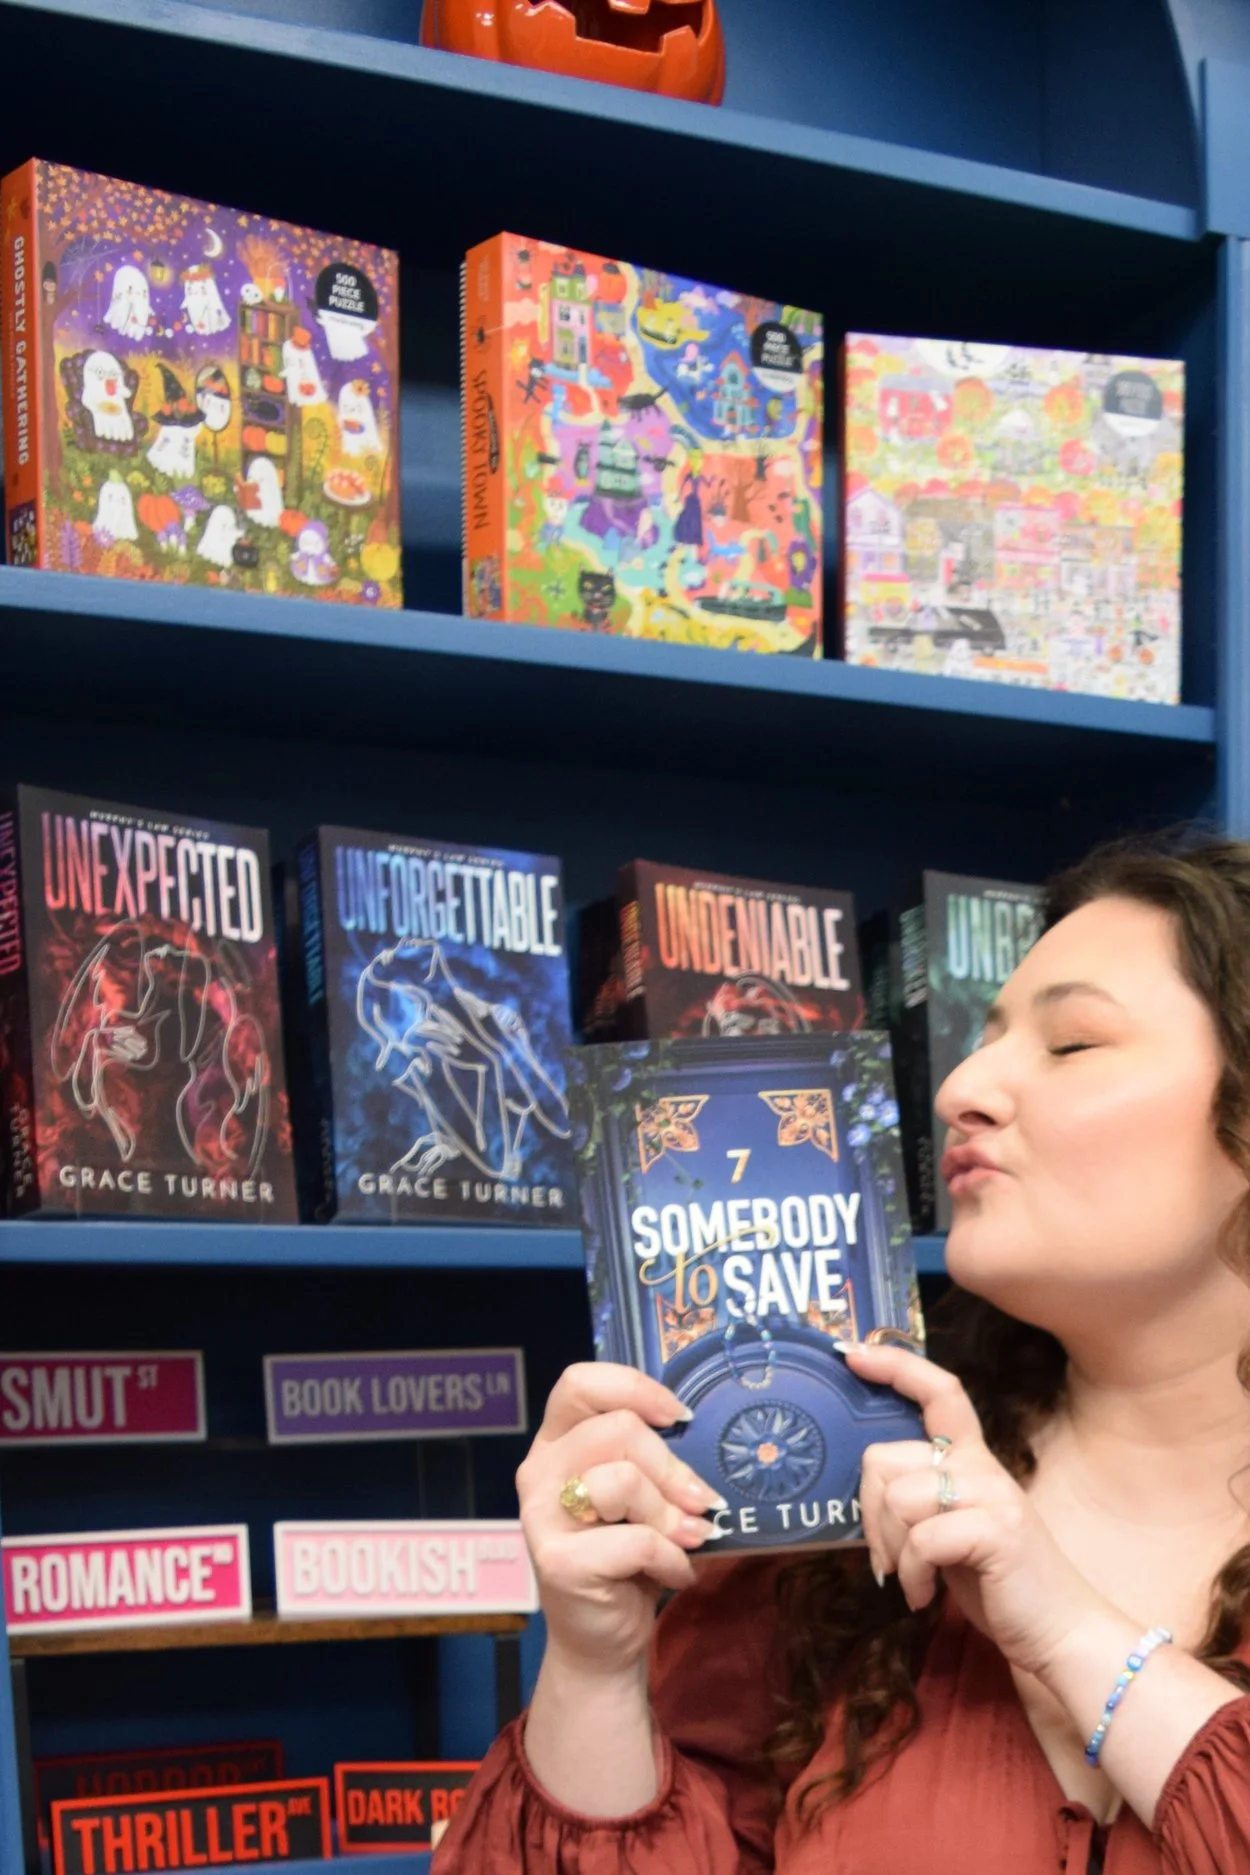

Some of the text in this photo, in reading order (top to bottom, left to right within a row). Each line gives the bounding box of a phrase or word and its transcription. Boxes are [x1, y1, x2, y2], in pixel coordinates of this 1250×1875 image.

[328, 295, 365, 313] PUZZLE
[331, 284, 361, 300] PIECE
[335, 272, 357, 287] 500
[13, 236, 29, 465] GHOSTLY GATHERING
[472, 369, 490, 531] SPOOKY TOWN
[41, 812, 263, 943] UNEXPECTED
[335, 845, 562, 957] UNFORGETTABLE
[655, 882, 851, 991] UNDENIABLE
[59, 1164, 274, 1204] GRACE TURNER
[357, 1172, 563, 1209] GRACE TURNER
[726, 1148, 751, 1184] 7
[631, 1193, 861, 1260] SOMEBODY
[639, 1224, 849, 1317] to SAVE
[1, 1364, 159, 1431] SMUT ST
[281, 1371, 511, 1419] BOOK LOVERS LN
[10, 1544, 216, 1616] ROMANCE
[292, 1537, 477, 1596] BOOKISH
[287, 1795, 313, 1817] AVE
[347, 1788, 425, 1826] DARK
